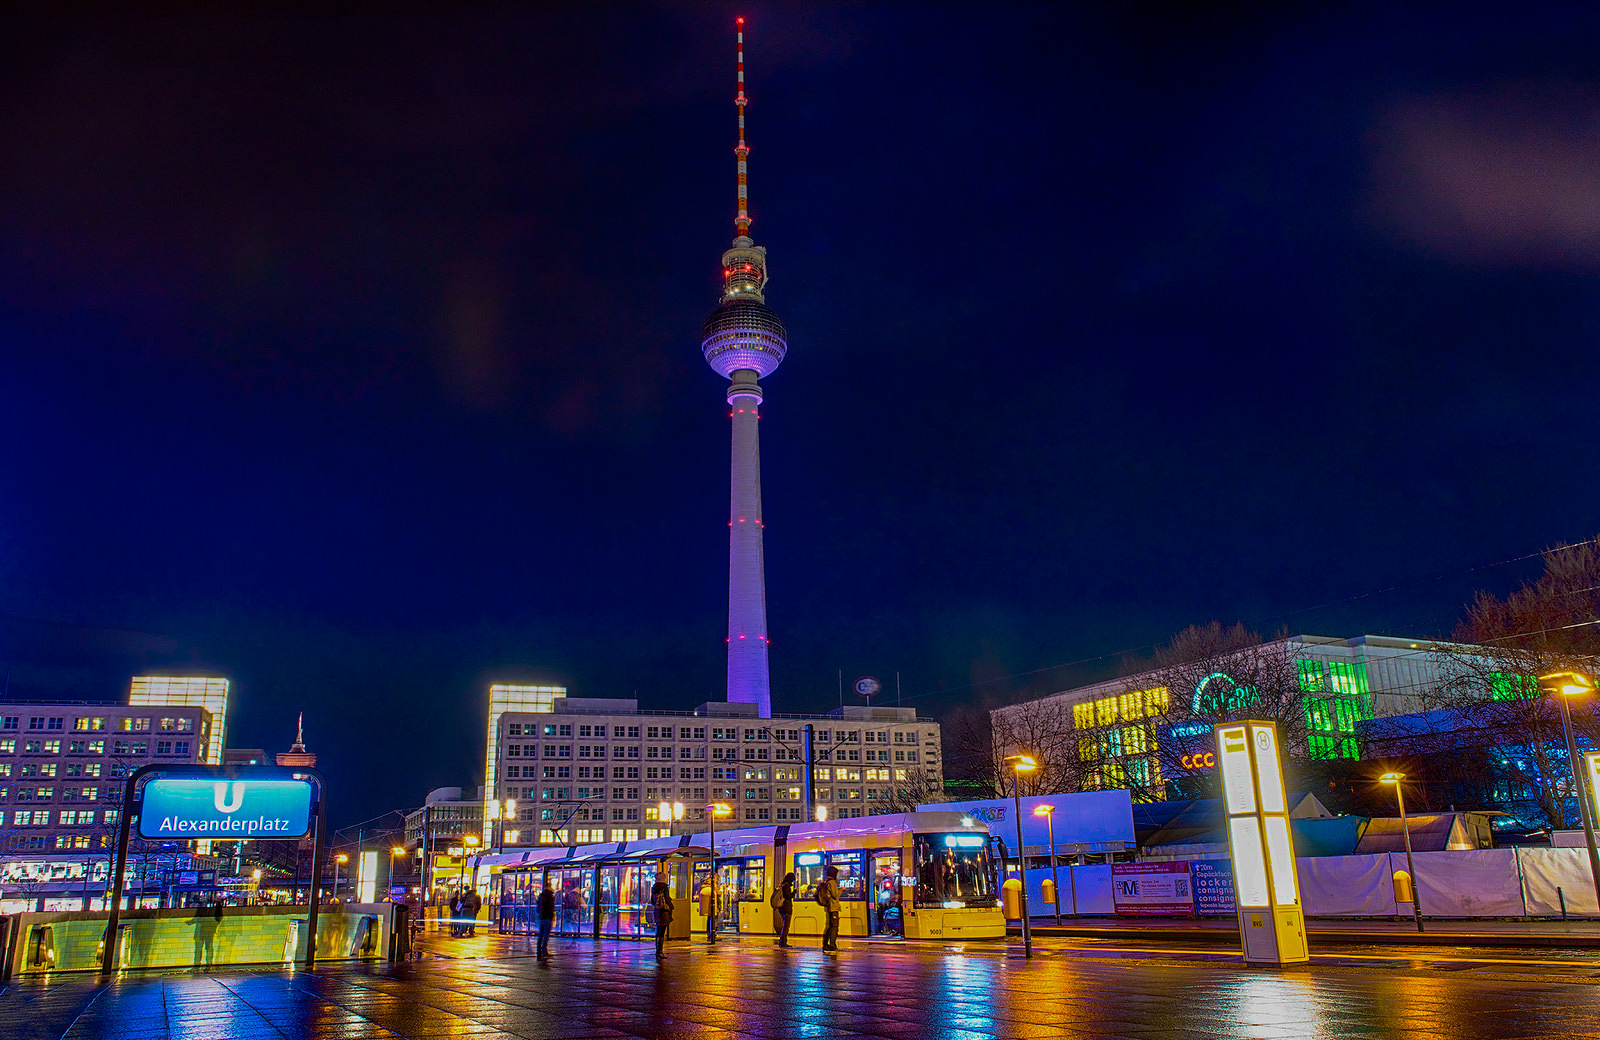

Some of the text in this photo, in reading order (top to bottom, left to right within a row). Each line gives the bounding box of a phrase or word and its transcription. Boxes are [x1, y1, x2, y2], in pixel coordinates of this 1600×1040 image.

[1181, 752, 1215, 769] CCC
[214, 782, 245, 813] U
[159, 815, 289, 835] Alexanderplatz
[1196, 878, 1232, 887] locker
[1197, 886, 1234, 895] consigna
[1198, 894, 1235, 903] consigne
[929, 928, 943, 936] 9003
